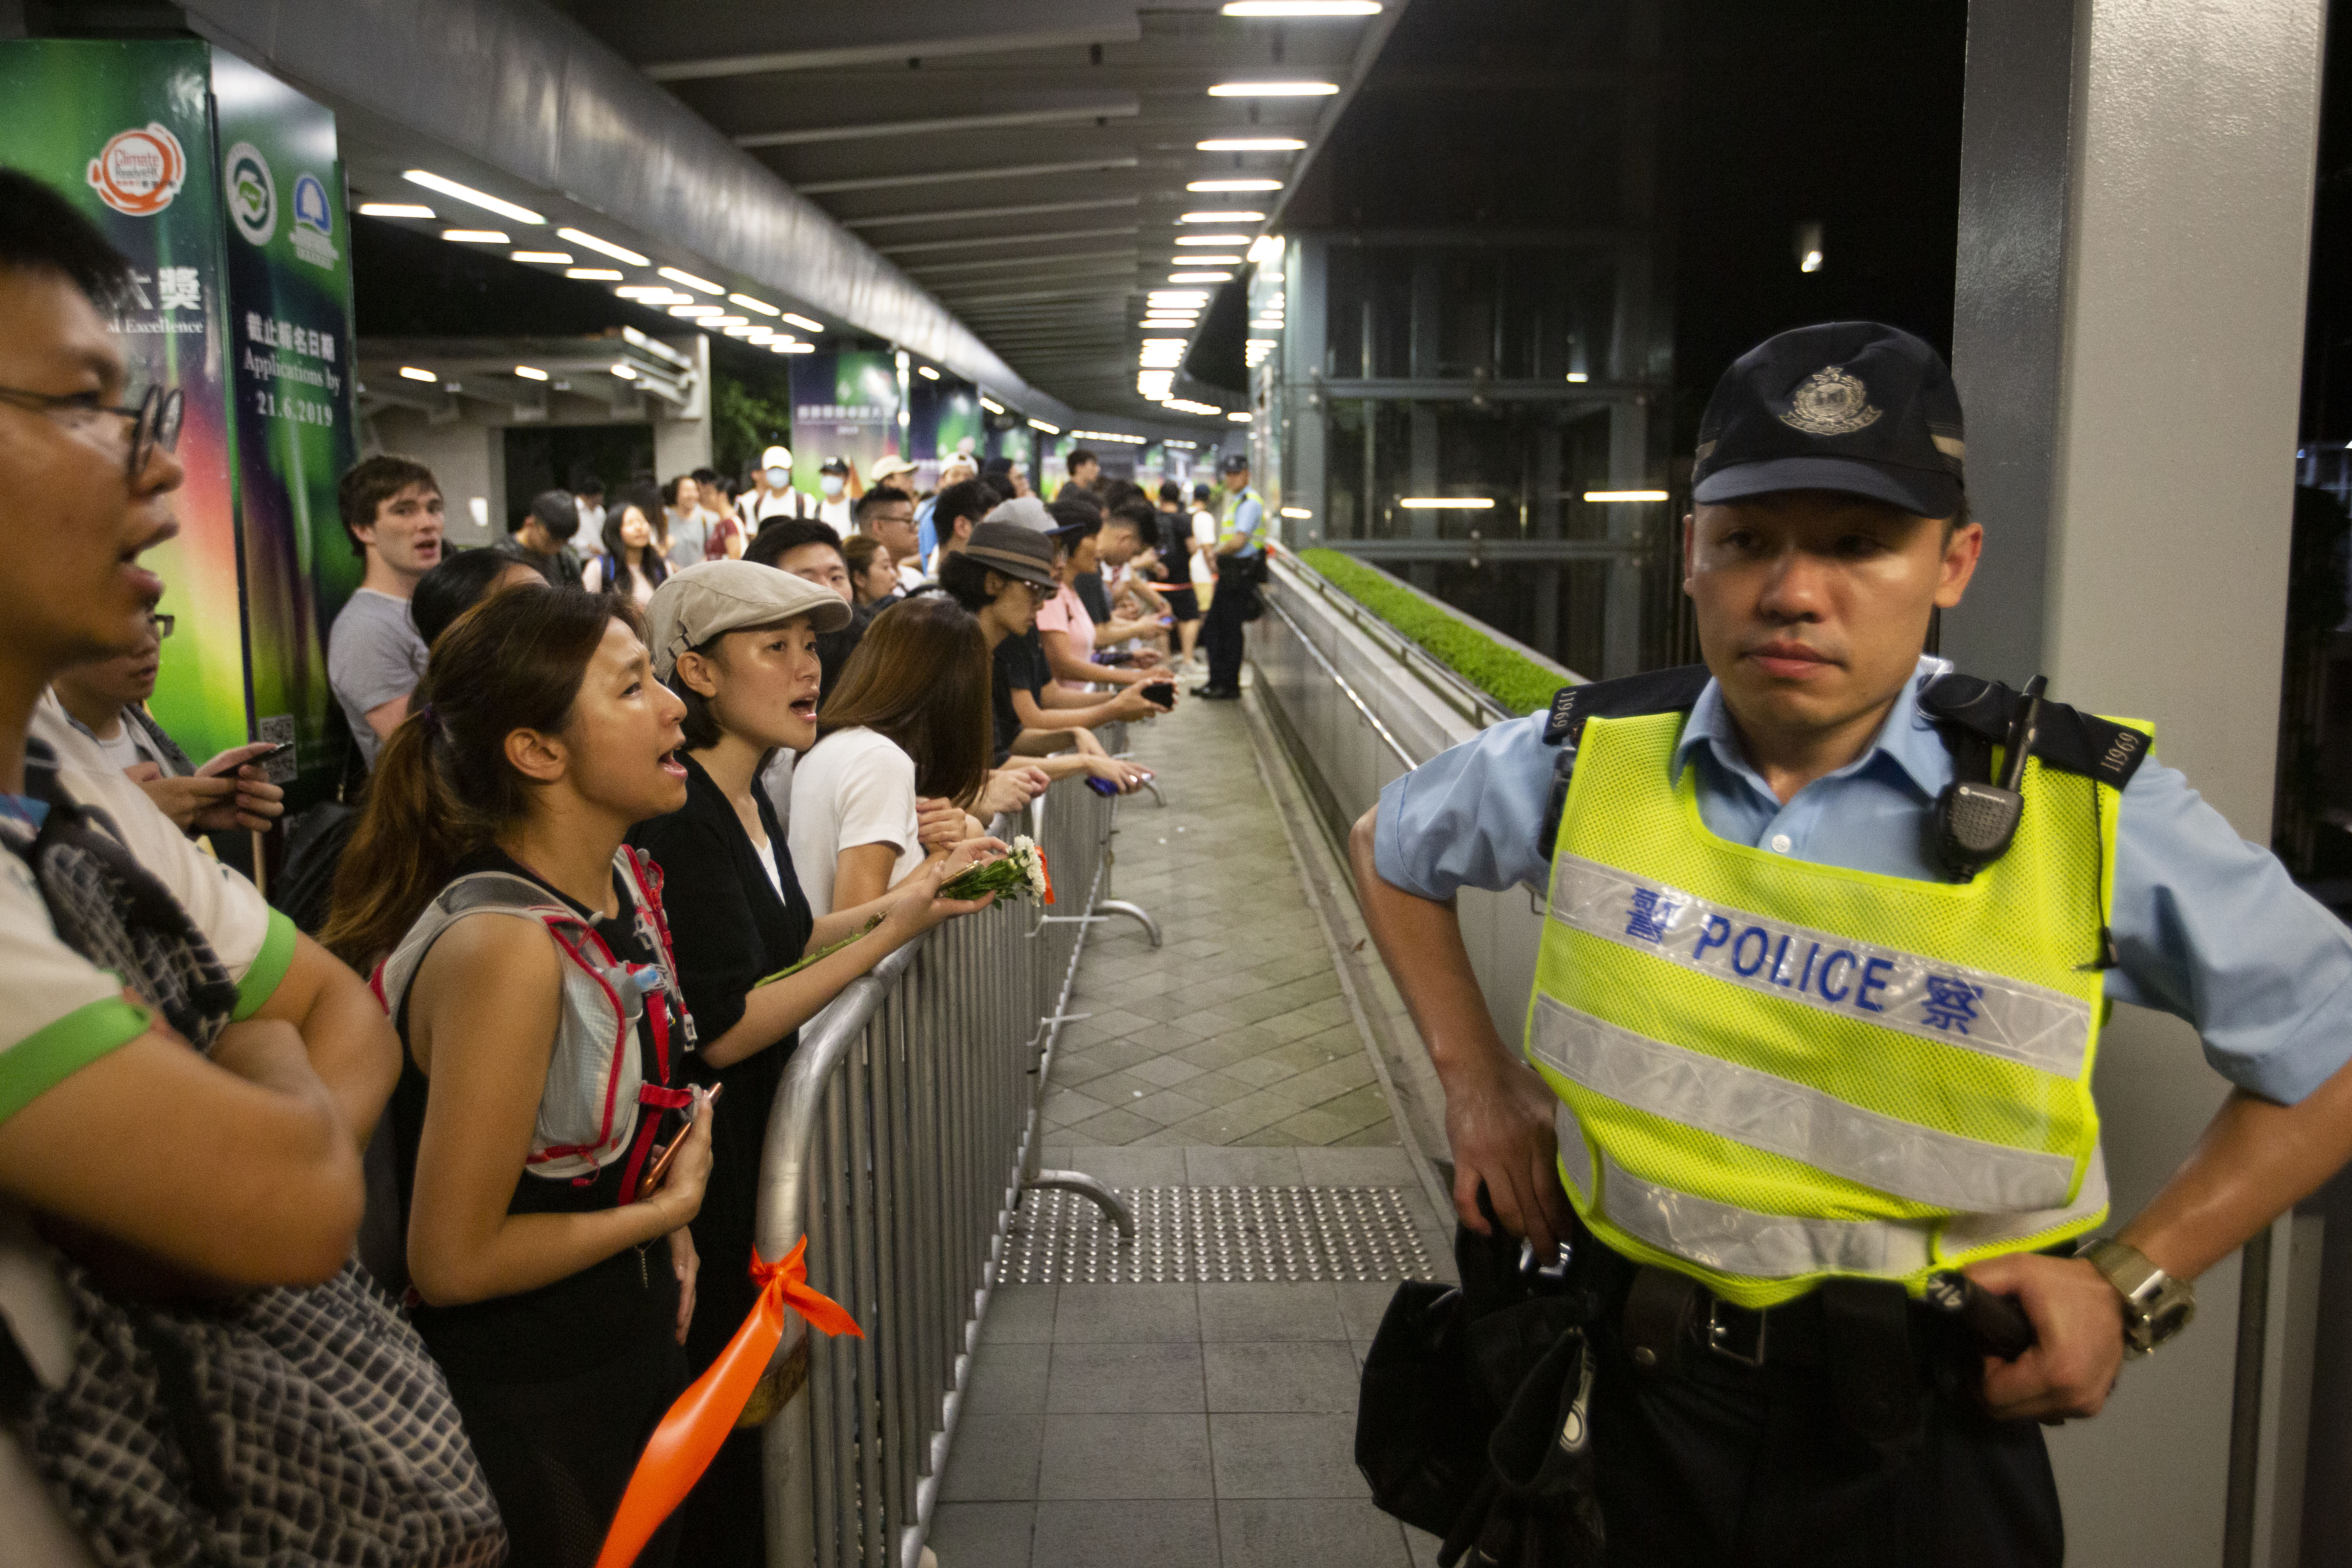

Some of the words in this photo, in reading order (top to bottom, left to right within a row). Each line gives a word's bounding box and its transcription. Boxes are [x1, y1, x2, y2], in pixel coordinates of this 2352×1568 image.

[126, 317, 203, 333] Excellence
[243, 347, 324, 387] Applications
[325, 365, 341, 397] by
[256, 389, 333, 427] 21.6.2019
[1552, 691, 1577, 728] 11969
[2100, 732, 2140, 773] 11969
[1692, 913, 1893, 1013] POLICE
[1920, 974, 1984, 1036] 察
